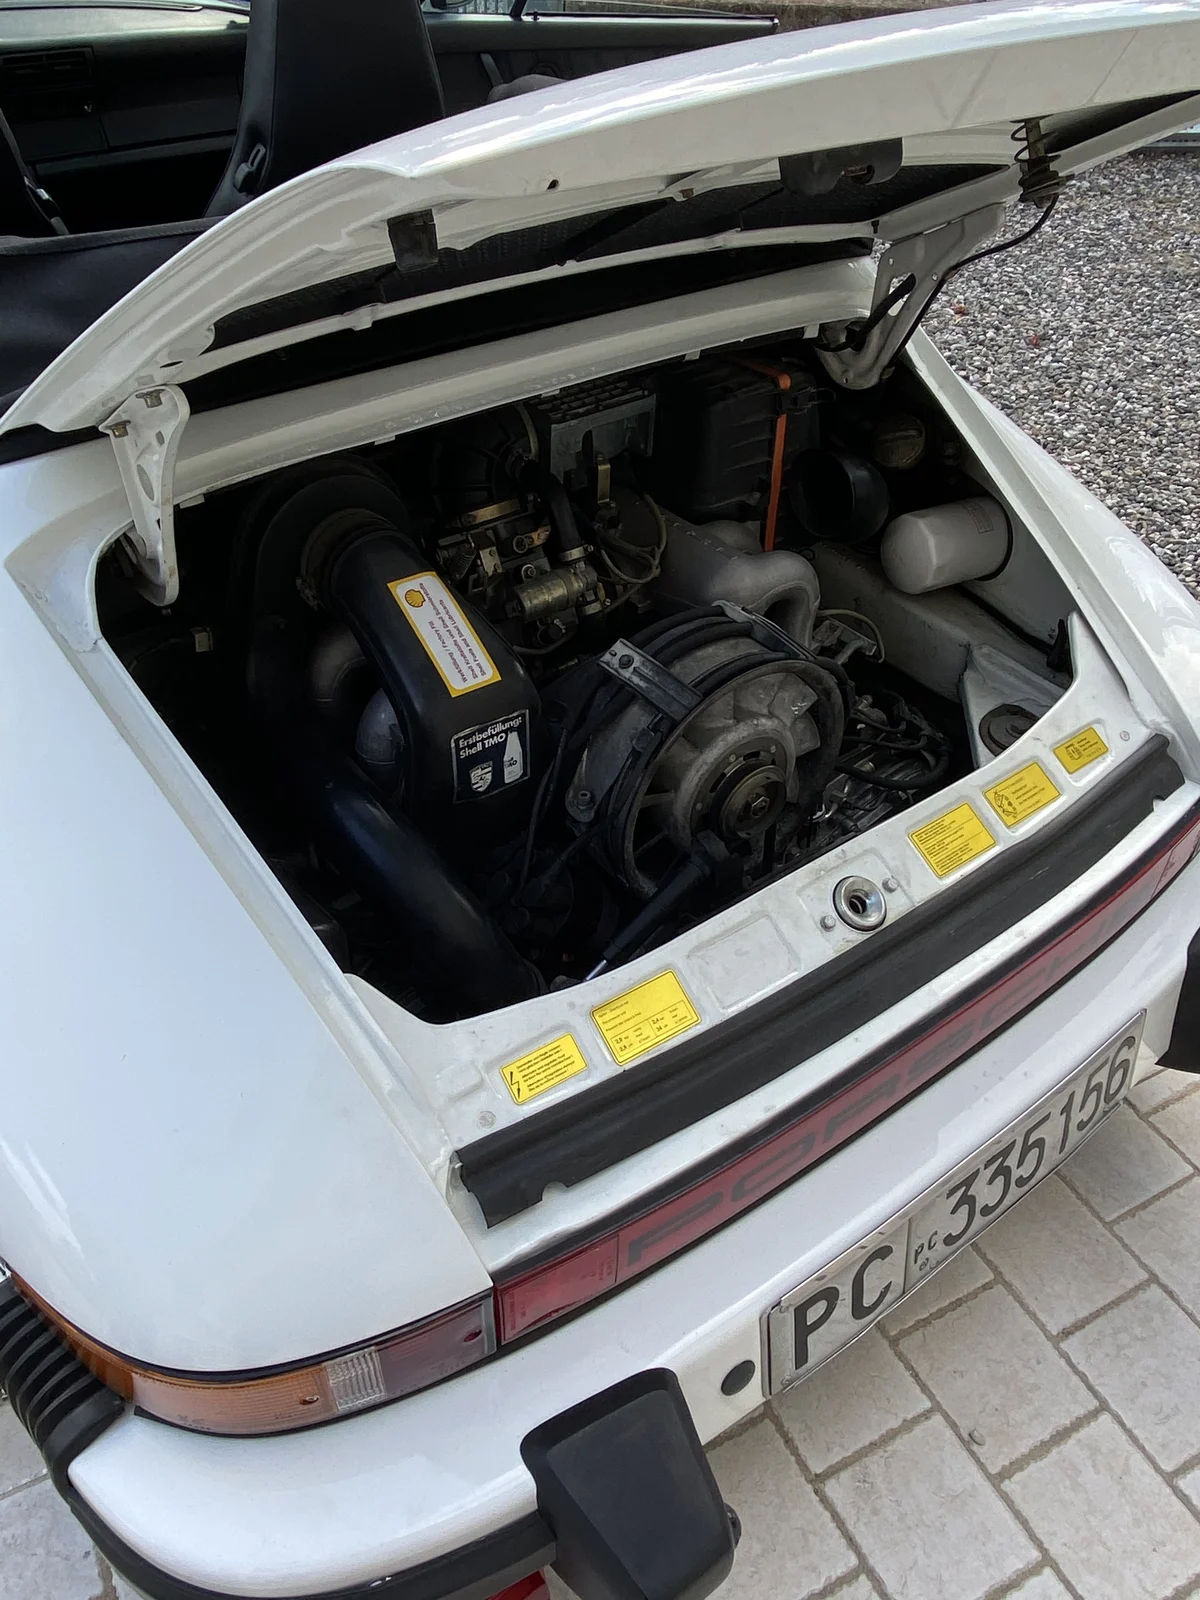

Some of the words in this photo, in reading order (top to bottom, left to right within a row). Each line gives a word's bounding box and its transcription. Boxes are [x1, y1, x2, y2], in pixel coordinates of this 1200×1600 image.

[439, 616, 448, 628] Shell
[454, 625, 463, 637] Shell
[468, 665, 478, 678] Shell
[476, 662, 486, 675] Shell
[459, 717, 522, 748] Erstbefüllung:
[460, 742, 482, 759] Shell
[484, 733, 506, 748] TMO
[628, 883, 1146, 1267] PORSCHE
[793, 1245, 893, 1370] PC
[943, 1036, 1135, 1247] 335156
